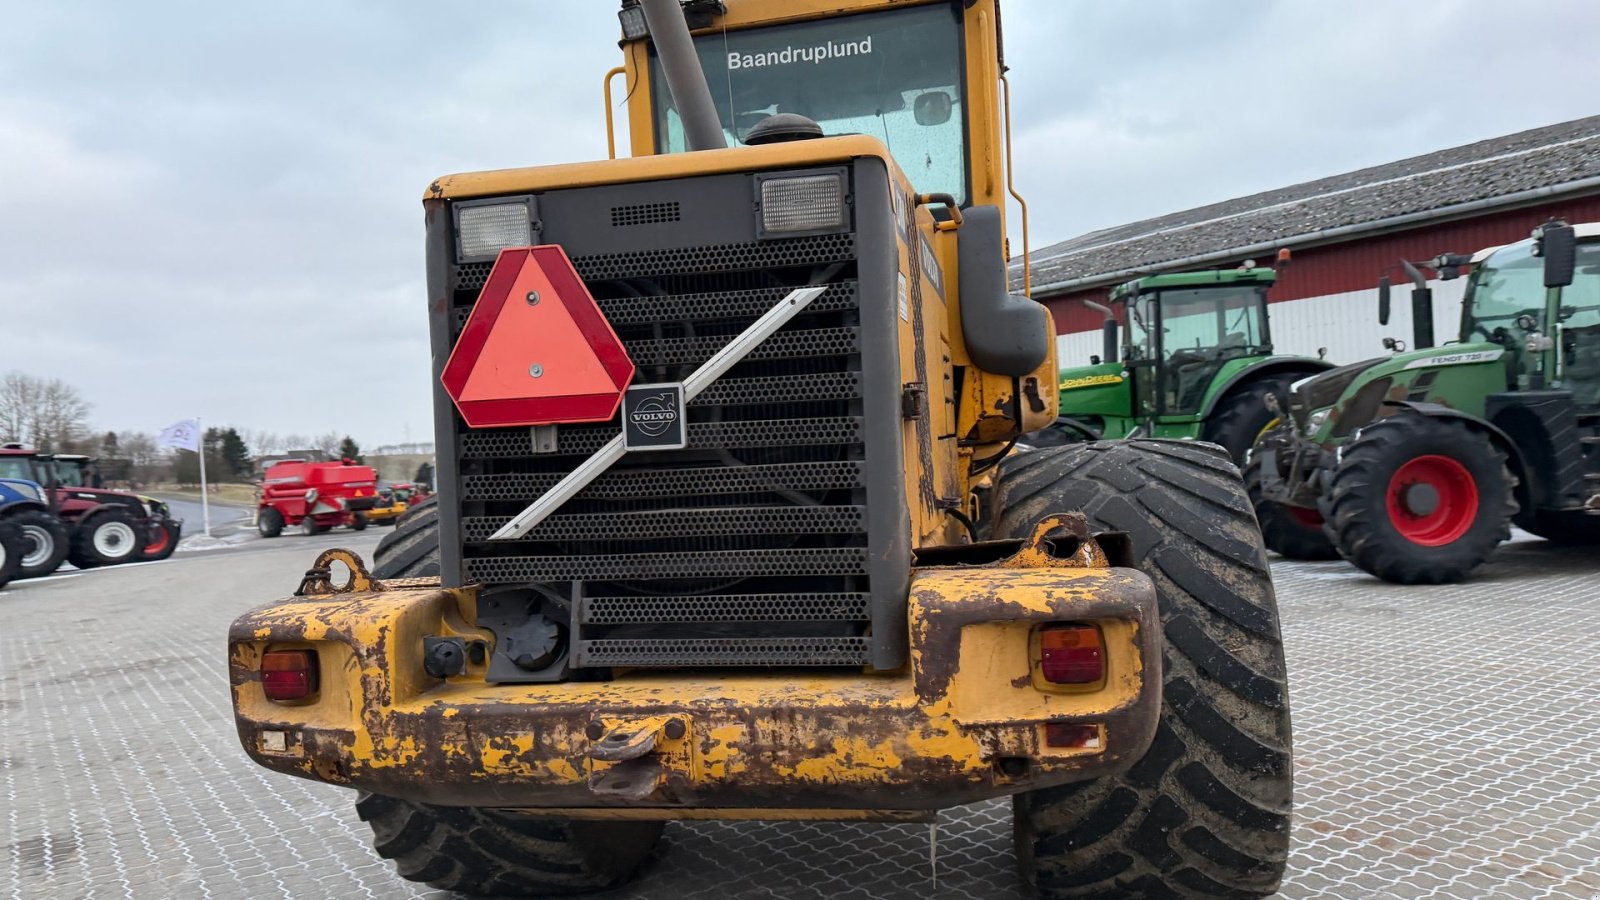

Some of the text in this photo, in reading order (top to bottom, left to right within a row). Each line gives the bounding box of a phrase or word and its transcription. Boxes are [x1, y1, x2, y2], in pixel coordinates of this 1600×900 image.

[727, 36, 872, 70] Baandruplund
[1431, 356, 1462, 364] FENDT
[632, 412, 675, 421] VOLVO
